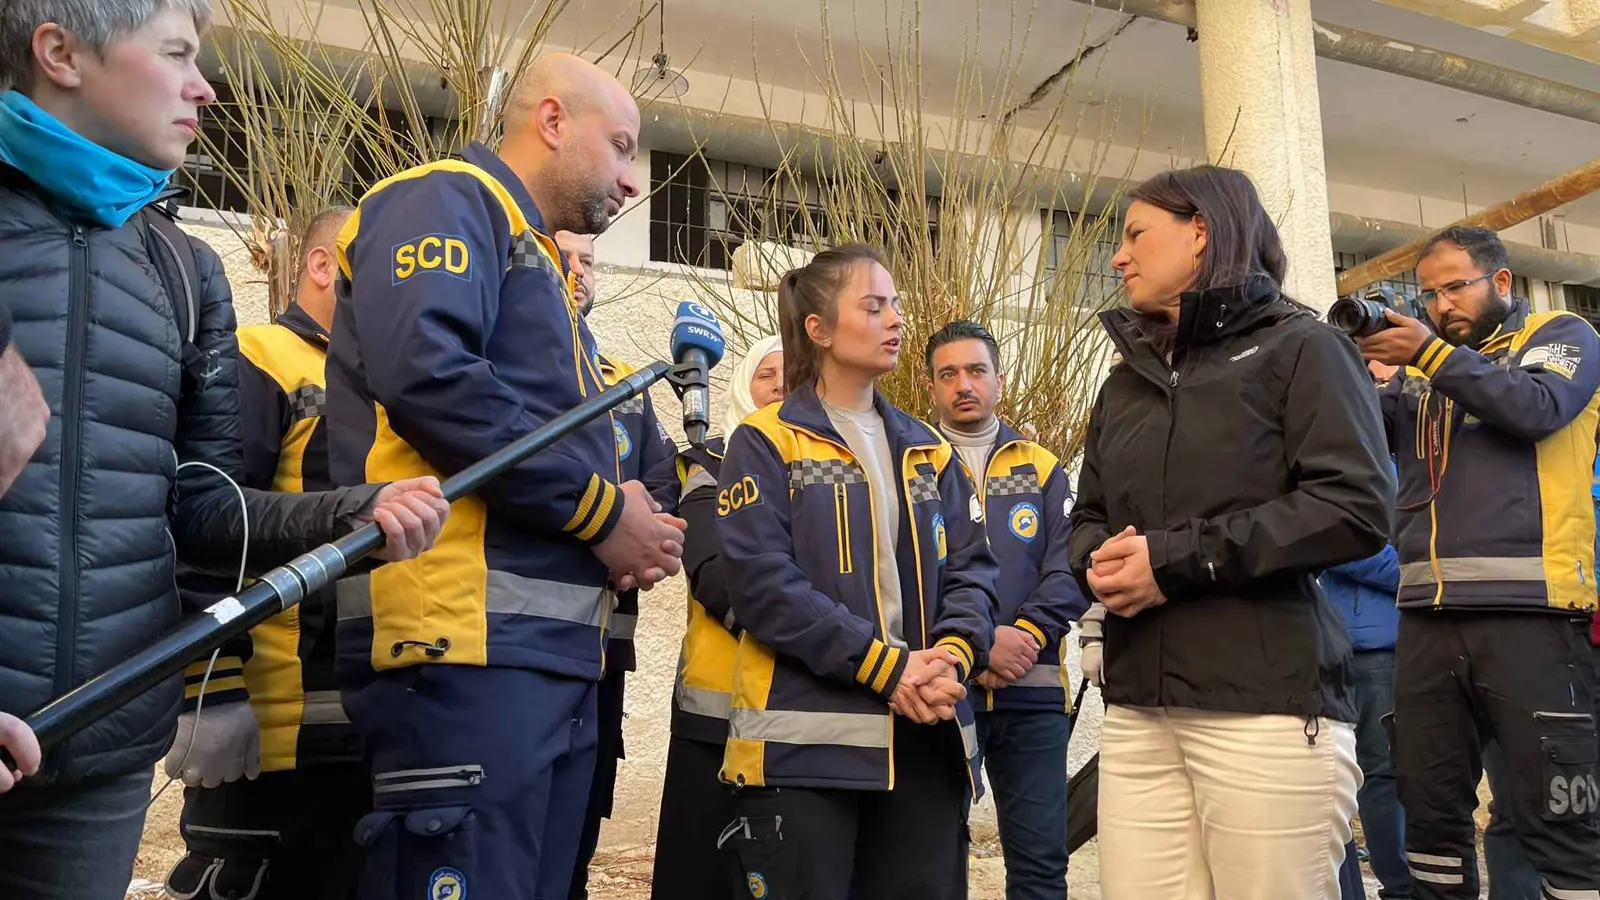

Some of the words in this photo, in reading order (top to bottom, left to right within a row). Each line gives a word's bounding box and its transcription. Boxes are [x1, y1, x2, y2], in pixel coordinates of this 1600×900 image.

[395, 236, 469, 279] SCD
[1548, 343, 1568, 356] THE
[717, 475, 759, 517] SCD
[1549, 774, 1599, 815] SCD
